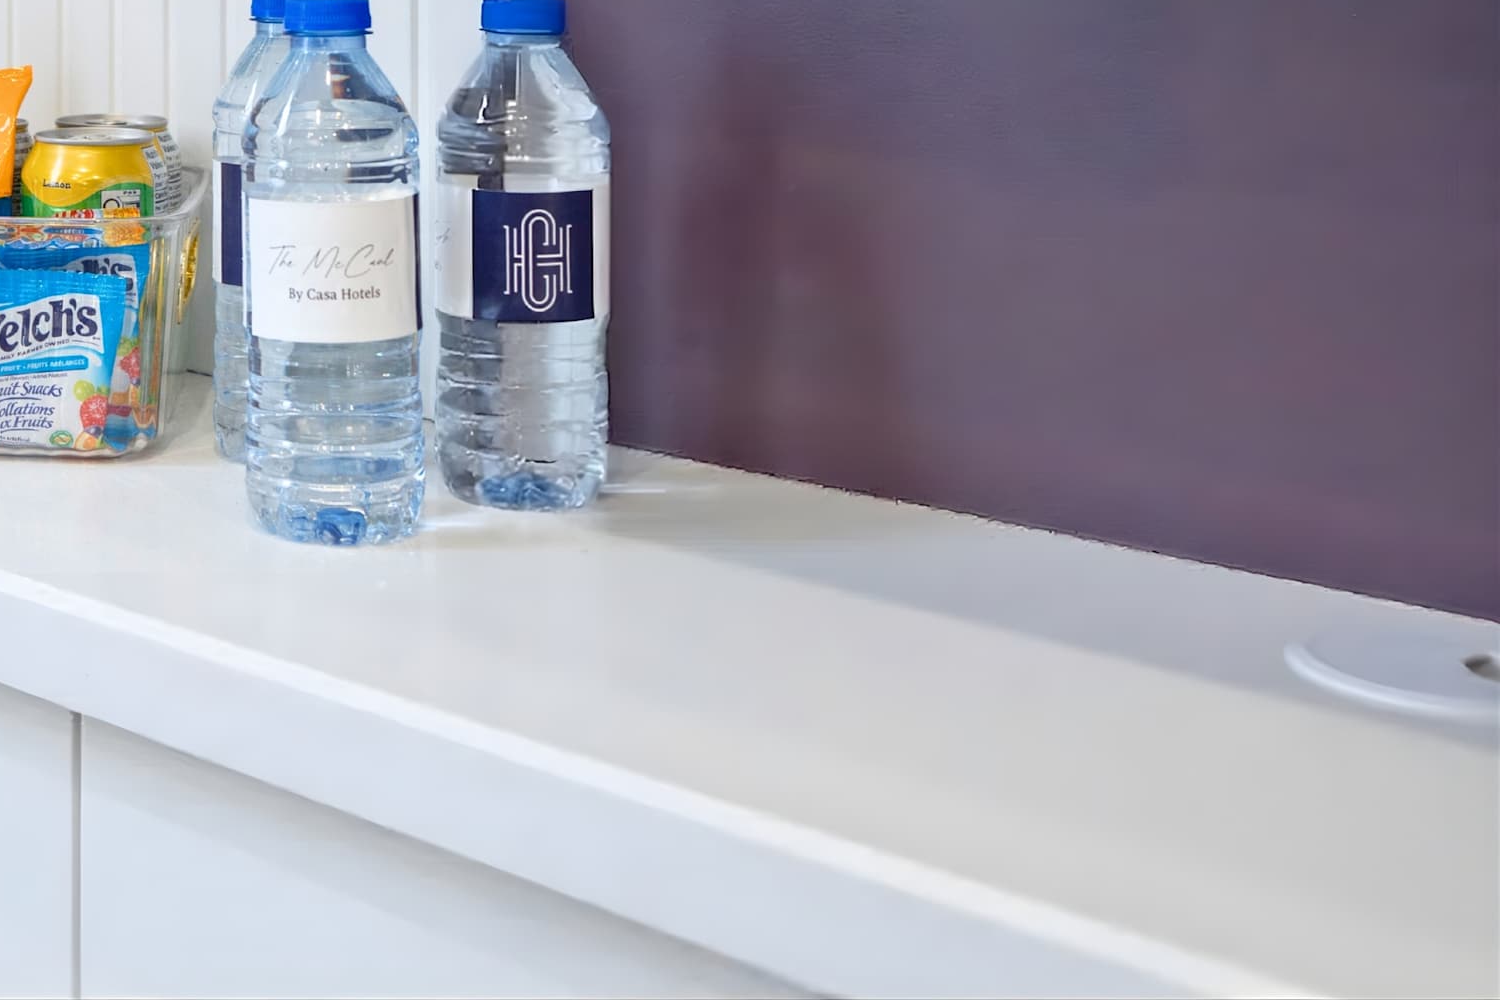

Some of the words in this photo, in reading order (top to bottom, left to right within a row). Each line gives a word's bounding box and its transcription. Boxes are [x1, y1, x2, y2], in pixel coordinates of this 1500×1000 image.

[268, 245, 296, 275] The
[288, 287, 303, 302] By
[306, 288, 338, 300] Casa
[341, 286, 381, 301] Hotels
[19, 381, 63, 398] Snacks
[10, 415, 55, 429] Fruits
